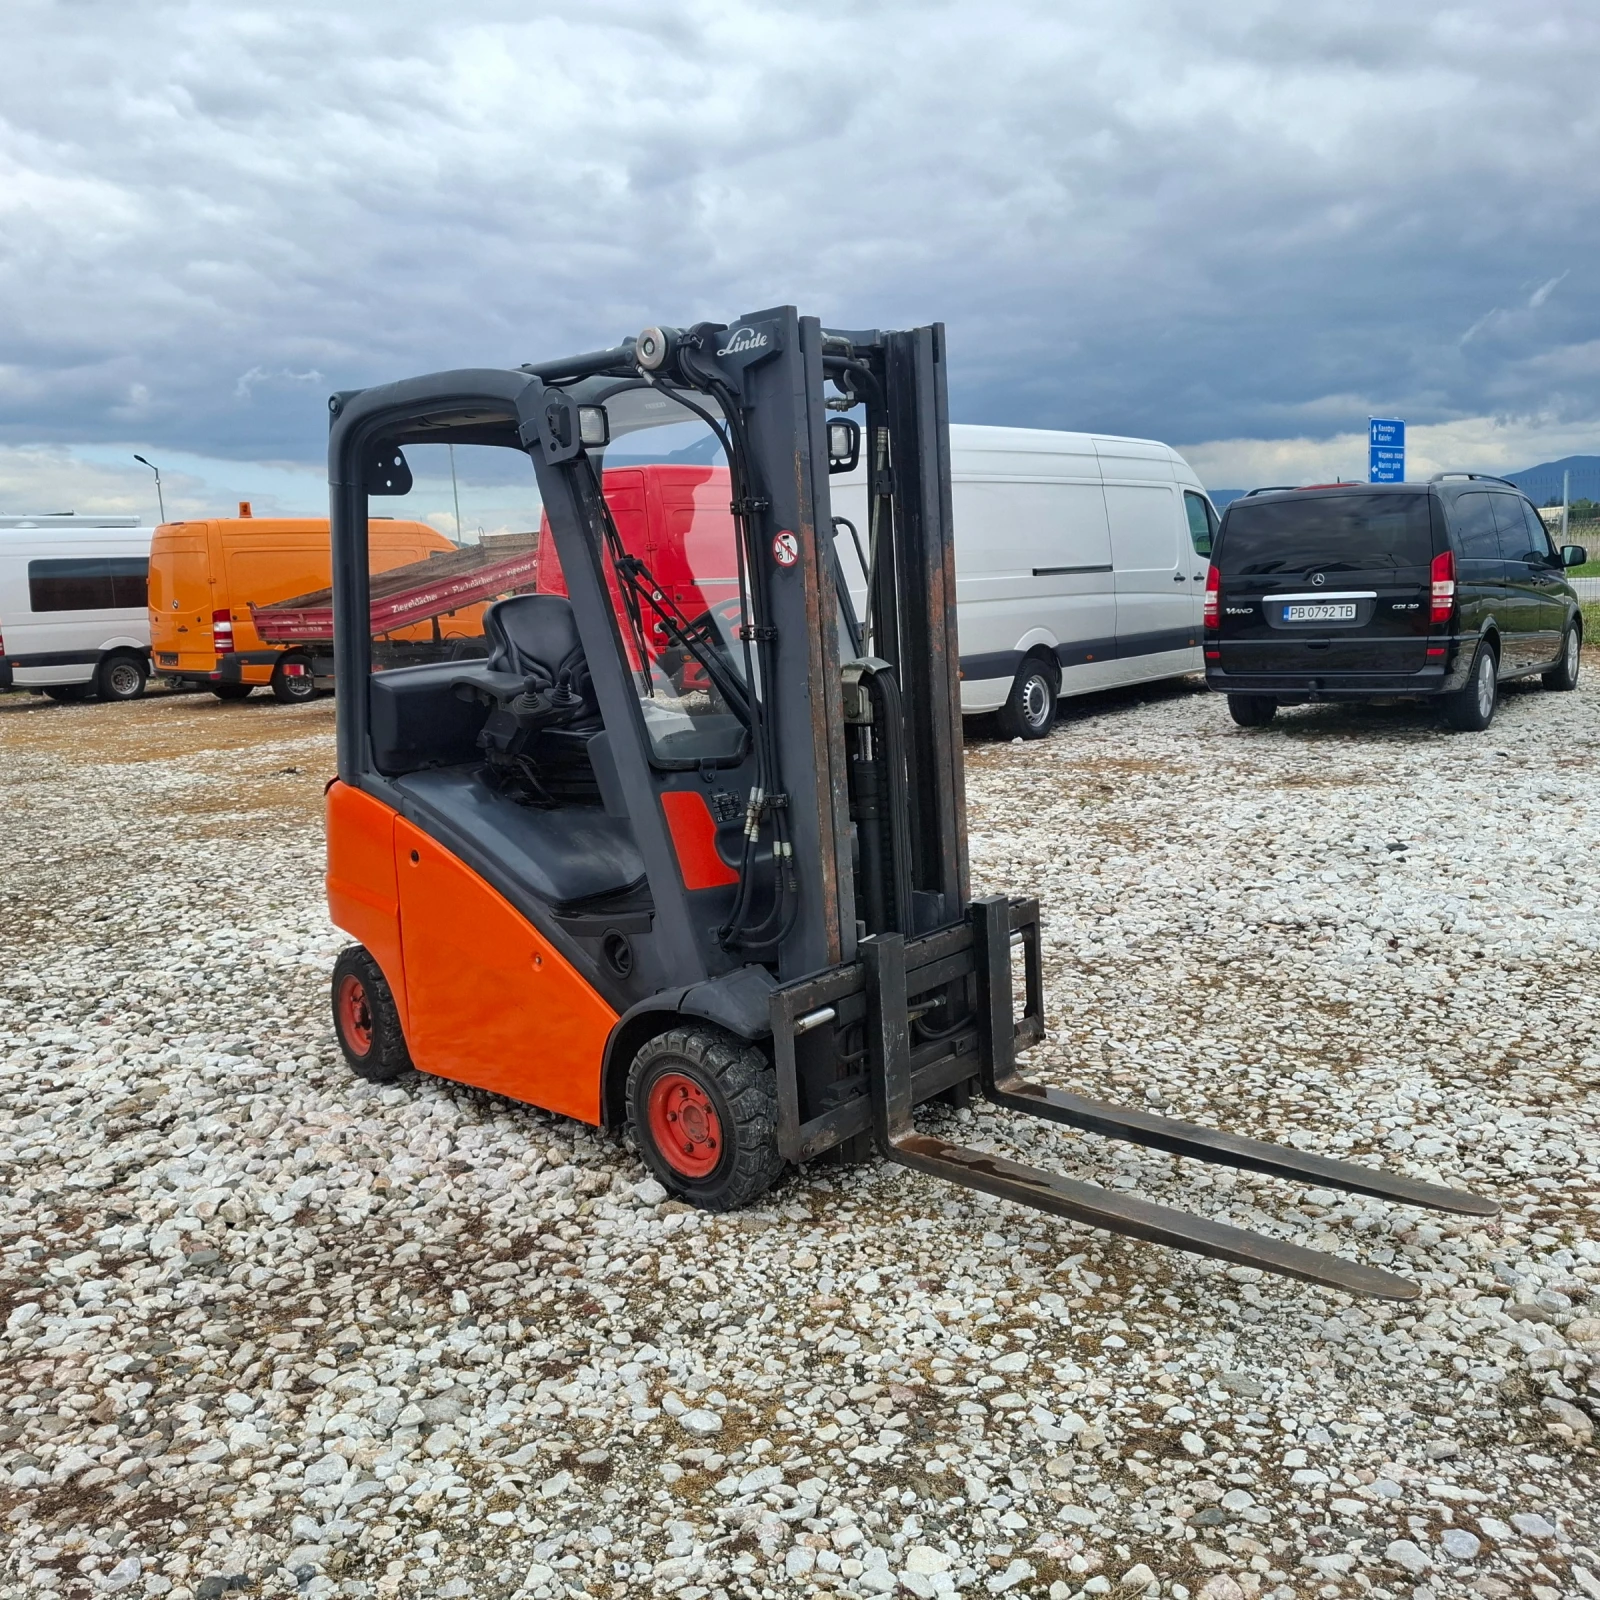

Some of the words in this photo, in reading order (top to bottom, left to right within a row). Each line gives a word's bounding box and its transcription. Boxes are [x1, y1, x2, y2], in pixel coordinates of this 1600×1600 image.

[716, 327, 768, 357] Linde
[391, 594, 438, 613] Ziegeldächer
[1290, 607, 1305, 618] PB
[1307, 606, 1336, 617] 0792
[1338, 605, 1354, 617] TB
